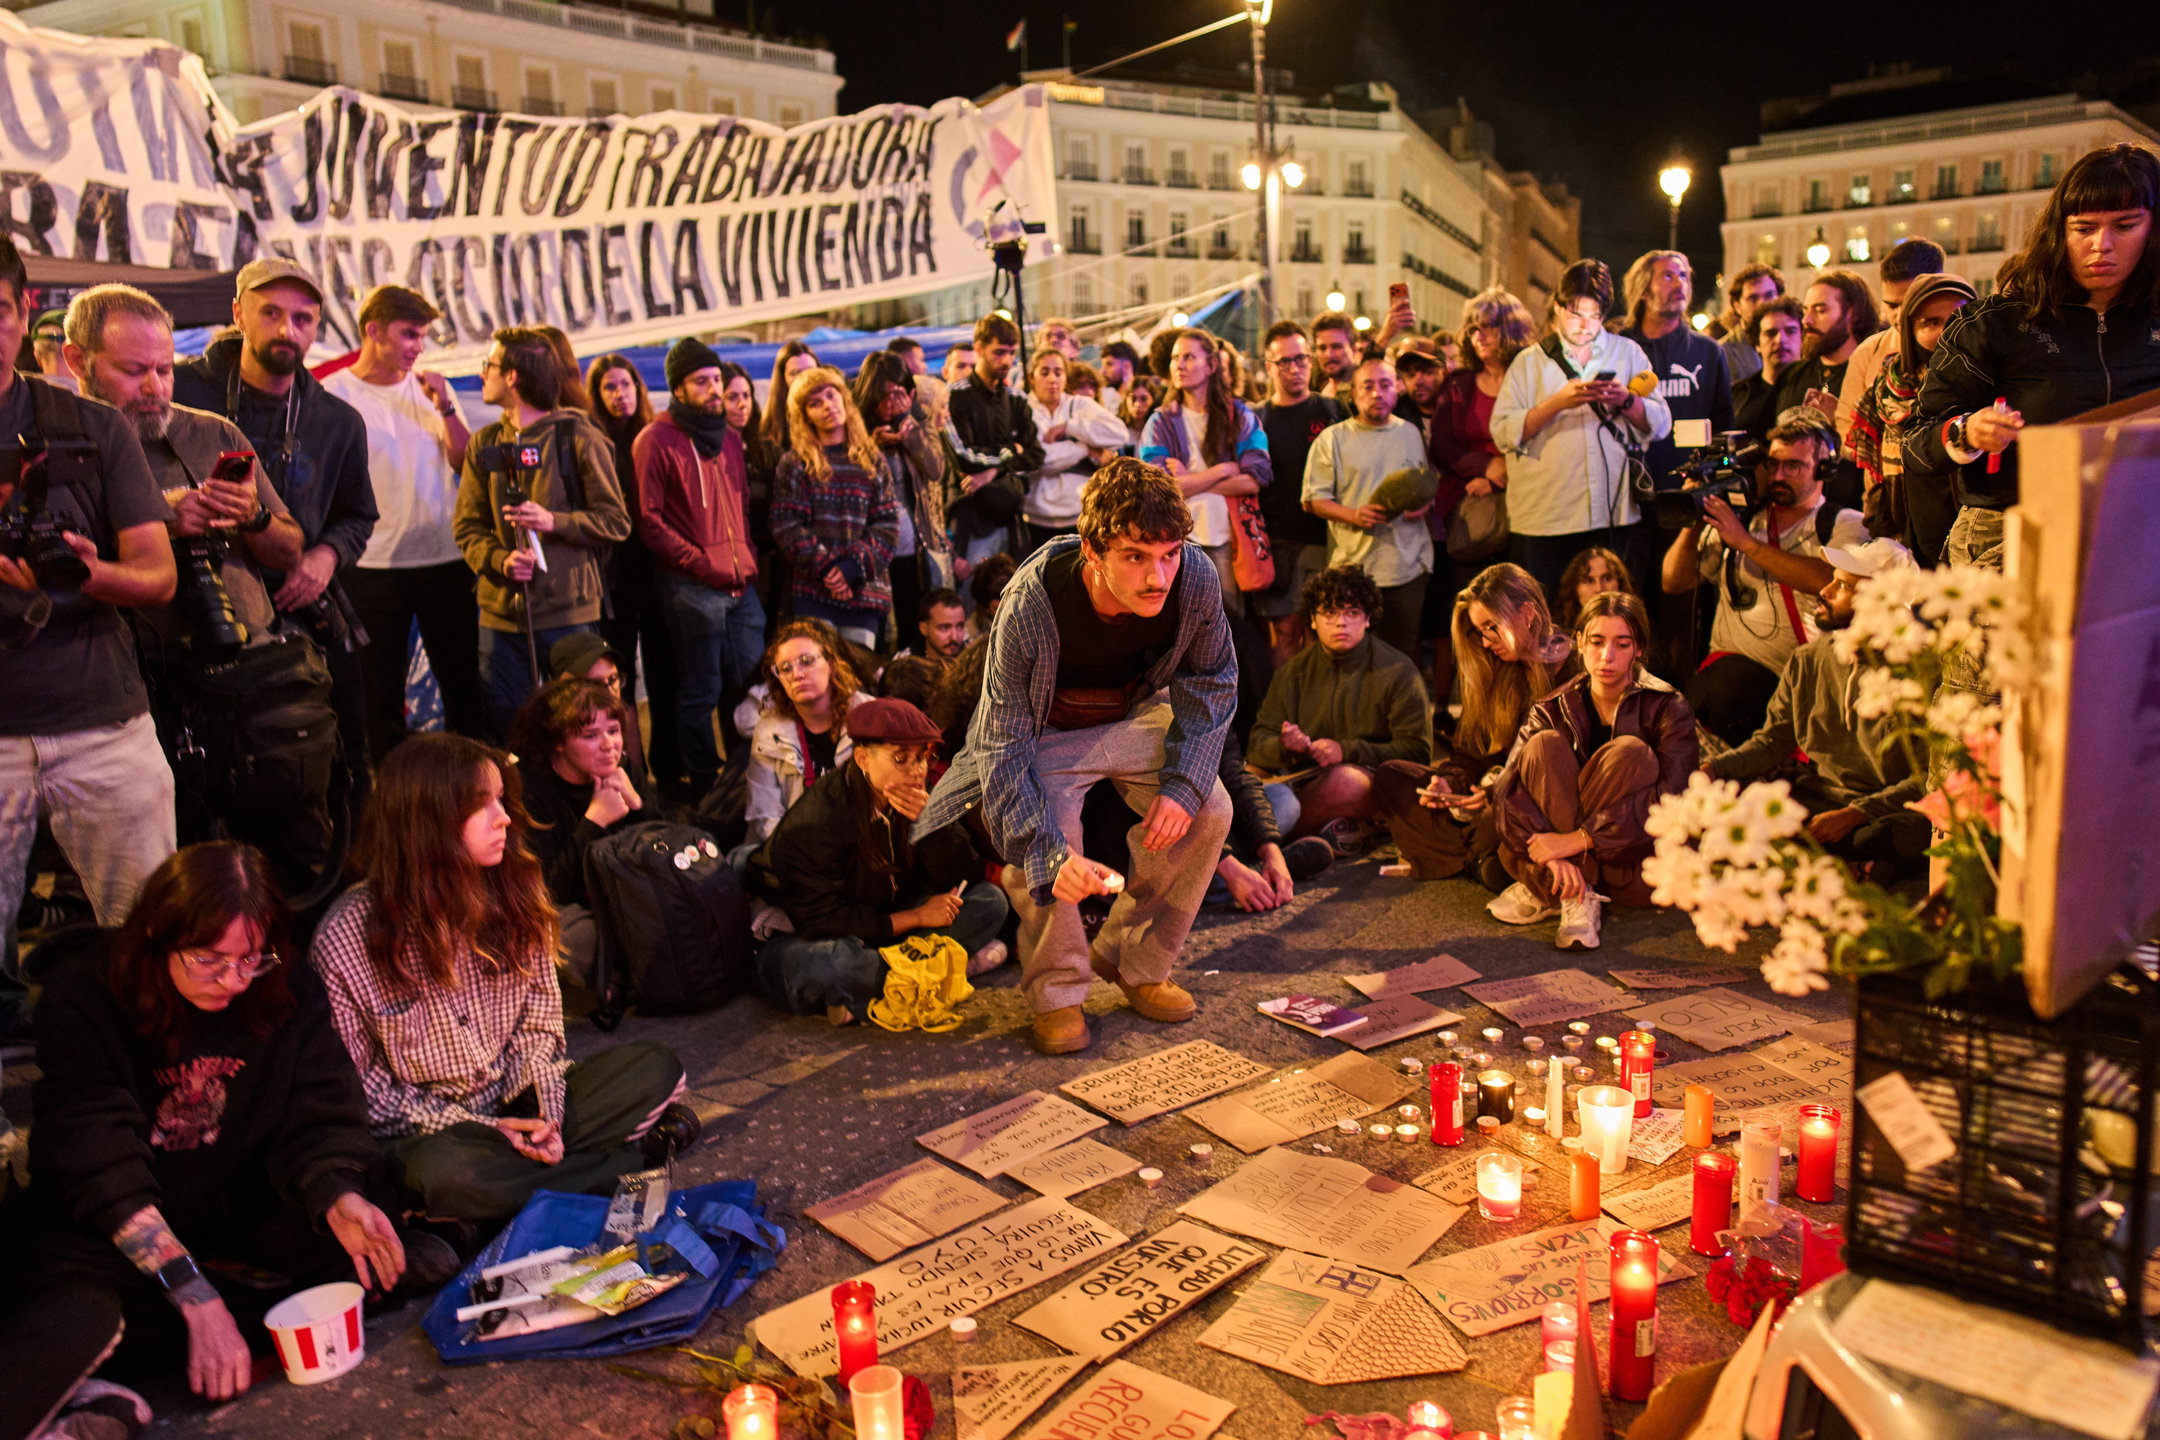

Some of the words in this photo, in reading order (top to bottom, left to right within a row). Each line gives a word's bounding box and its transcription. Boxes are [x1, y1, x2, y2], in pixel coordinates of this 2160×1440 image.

[290, 97, 612, 222] JUVENTUD
[607, 113, 942, 210] TRABAJADORA
[561, 223, 632, 332] DE
[640, 219, 709, 320] LA
[718, 197, 939, 306] VIVIENDA
[1659, 992, 1752, 1026] ALTO
[1713, 1014, 1792, 1038] VUELA
[1772, 1047, 1810, 1064] NOS
[1801, 1056, 1840, 1073] POR
[1230, 1064, 1264, 1080] una
[1752, 1075, 1796, 1089] TODO
[1154, 1097, 1182, 1108] un
[994, 1209, 1074, 1252] SEGUIRÁ
[1036, 1234, 1061, 1249] LO
[1057, 1219, 1093, 1236] POR
[1519, 1226, 1604, 1258] LAZAS
[990, 1248, 1034, 1272] QUE
[1048, 1229, 1112, 1262] VAMOS
[1156, 1245, 1208, 1274] QUE
[907, 1246, 988, 1288] SIENDO
[1028, 1259, 1046, 1272] A
[1178, 1245, 1255, 1293] LUCHAD
[932, 1269, 1024, 1318] SEGUIR
[1114, 1276, 1160, 1300] ES
[1447, 1277, 1582, 1323] GORRIONES
[1124, 1292, 1181, 1326] POR
[1100, 1320, 1139, 1342] LO
[1151, 1408, 1211, 1440] LO
